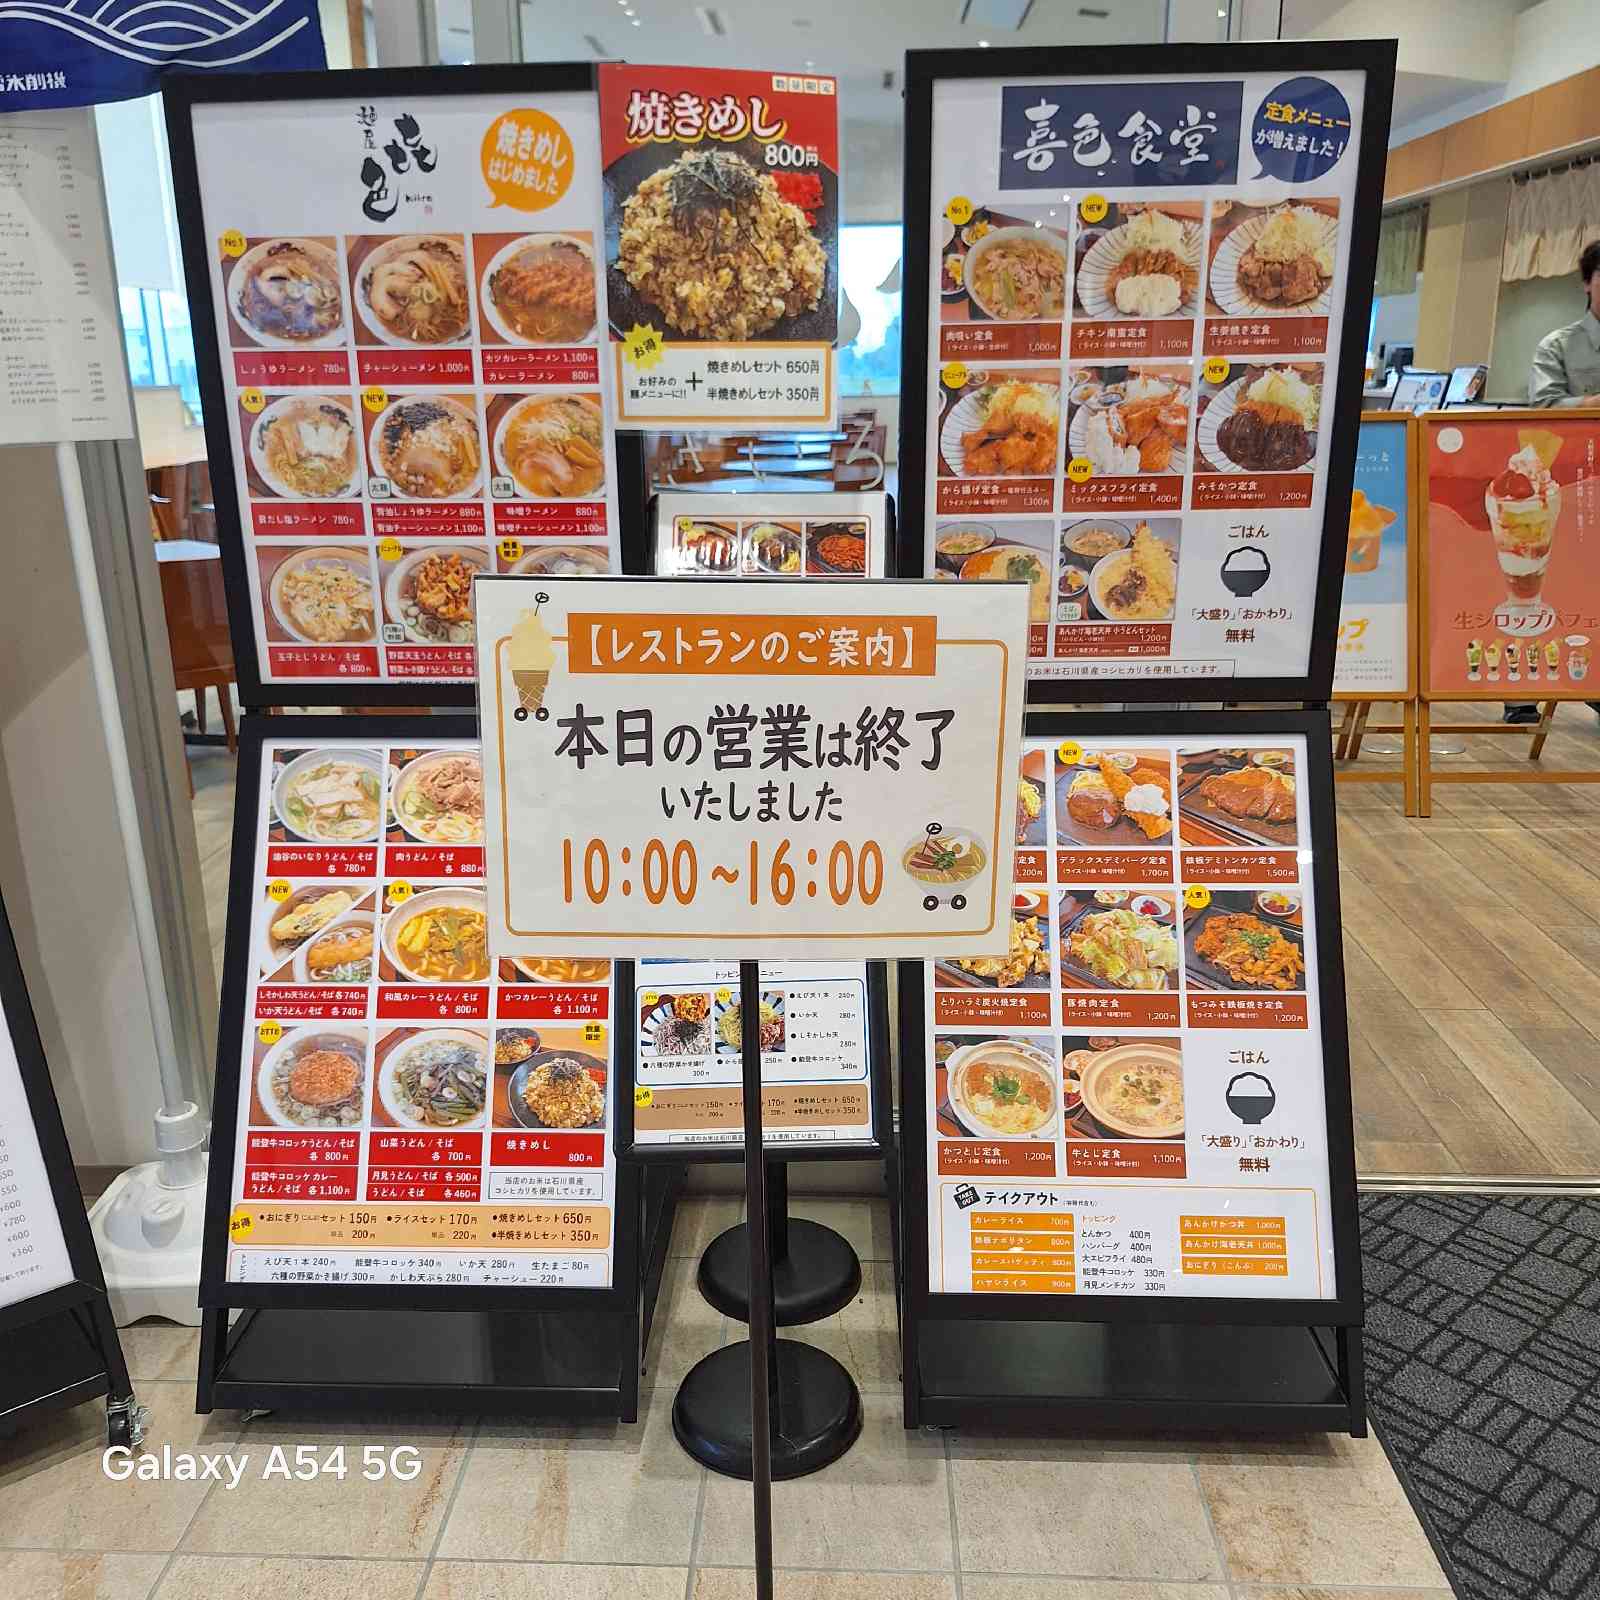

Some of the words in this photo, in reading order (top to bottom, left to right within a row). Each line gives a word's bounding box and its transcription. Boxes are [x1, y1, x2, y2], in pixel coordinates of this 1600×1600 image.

[627, 91, 785, 140] 焼きめし
[1264, 100, 1351, 129] 定食メニュー
[1012, 97, 1218, 173] 喜色食堂
[496, 118, 568, 169] 焼きめし
[764, 145, 819, 168] 800円
[487, 155, 560, 194] はじめました
[1208, 325, 1272, 336] 生姜焼き定食
[485, 352, 560, 363] カツカレーラーメン
[240, 364, 316, 375] しょうゆラーメン
[362, 363, 436, 374] チャーシューメン
[706, 360, 782, 374] 焼きめしセット
[489, 371, 555, 381] カレーラーメン
[571, 370, 596, 381] 800円
[638, 377, 677, 387] お好みの
[365, 394, 385, 403] NEW
[706, 387, 783, 401] 半焼きめしセット
[1072, 465, 1090, 474] NEW
[942, 484, 1000, 496] から揚げ定食
[1070, 483, 1158, 494] ミックスフライ定食
[1197, 481, 1259, 492] みそかつ定食
[505, 507, 559, 517] 味噌ラーメン
[496, 523, 575, 533] 味噌チャーシューメン
[1228, 524, 1271, 539] ごはん
[1452, 609, 1600, 631] 生シロップパフェ
[1225, 628, 1257, 643] 無料
[590, 622, 914, 670] 【レストランのご案内】
[554, 702, 957, 772] 本日の営業は終了
[660, 779, 843, 823] いたしました
[1059, 855, 1168, 865] デラックスデミバーグ定食
[1184, 855, 1278, 865] 鉄板デミトンカツ定食
[271, 885, 290, 894] NEW
[383, 992, 478, 1001] 和風カレーうどん/そば
[505, 992, 599, 1002] かつカレーうどん/そば
[940, 997, 1029, 1007] とりハラミ炭火焼定食
[1067, 998, 1121, 1008] 豚焼肉定食
[1191, 1000, 1284, 1010] もつみそ鉄板焼き定食
[1228, 1050, 1271, 1064] ごはん
[379, 1138, 454, 1148] 山菜うどん/そば
[506, 1139, 552, 1151] 焼きめし
[568, 1152, 593, 1162] 800円
[943, 1147, 1002, 1157] かつとじ定食
[1023, 1152, 1053, 1162] 1,200円
[1071, 1148, 1121, 1159] 牛とじ定食
[1152, 1154, 1183, 1164] 1,100円
[1238, 1157, 1271, 1172] 無料
[504, 1176, 584, 1186] 当店のお米は石川県産
[495, 1187, 597, 1196] コシヒカリを使用しています。
[984, 1191, 1059, 1206] テイクアウト
[230, 1217, 252, 1231] お得
[349, 1212, 377, 1225] 150円
[393, 1214, 446, 1225] ライスセット
[449, 1214, 479, 1225] 170円
[498, 1213, 560, 1224] 焼きめしセット
[562, 1212, 592, 1225] 650円
[975, 1216, 1025, 1225] カレーライス
[497, 1230, 566, 1241] 半焼きめしセット
[570, 1230, 600, 1242] 350円
[1081, 1230, 1112, 1239] とんかつ
[1129, 1230, 1152, 1240] 400円
[1081, 1242, 1121, 1250] ハンバーグ
[1130, 1242, 1153, 1252] 400円
[458, 1260, 487, 1269] いか天
[1081, 1255, 1127, 1263] 大エビフライ
[530, 1261, 570, 1271] 生たまご
[1143, 1269, 1166, 1278] 330円
[1083, 1280, 1137, 1290] 月見メンチカツ
[1144, 1282, 1167, 1291] 330円
